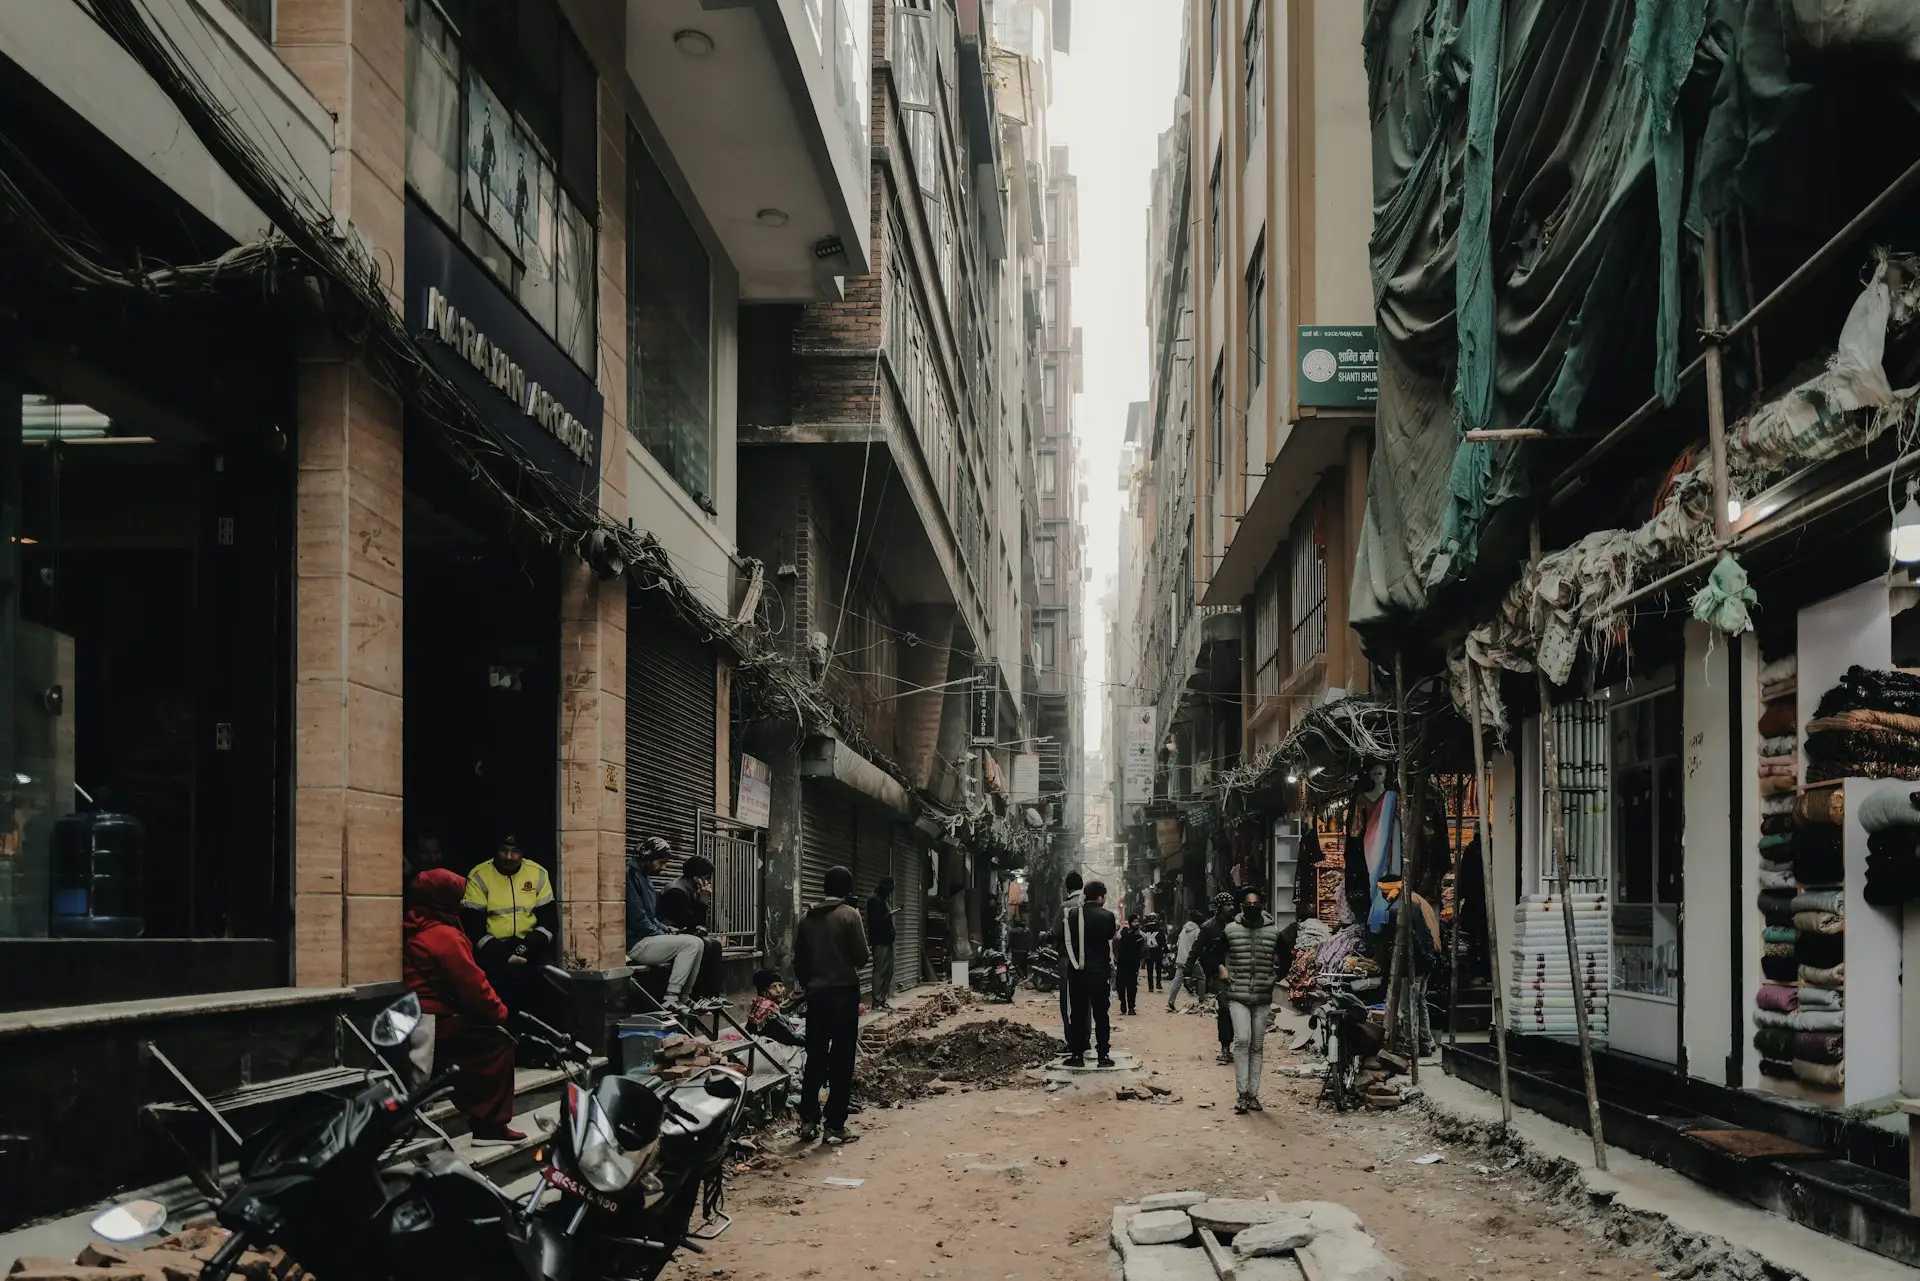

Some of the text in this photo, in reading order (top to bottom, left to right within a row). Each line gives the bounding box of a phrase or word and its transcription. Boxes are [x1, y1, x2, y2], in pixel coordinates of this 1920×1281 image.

[427, 286, 594, 468] NARAYAN ARCADE
[1338, 371, 1360, 382] SHANTI
